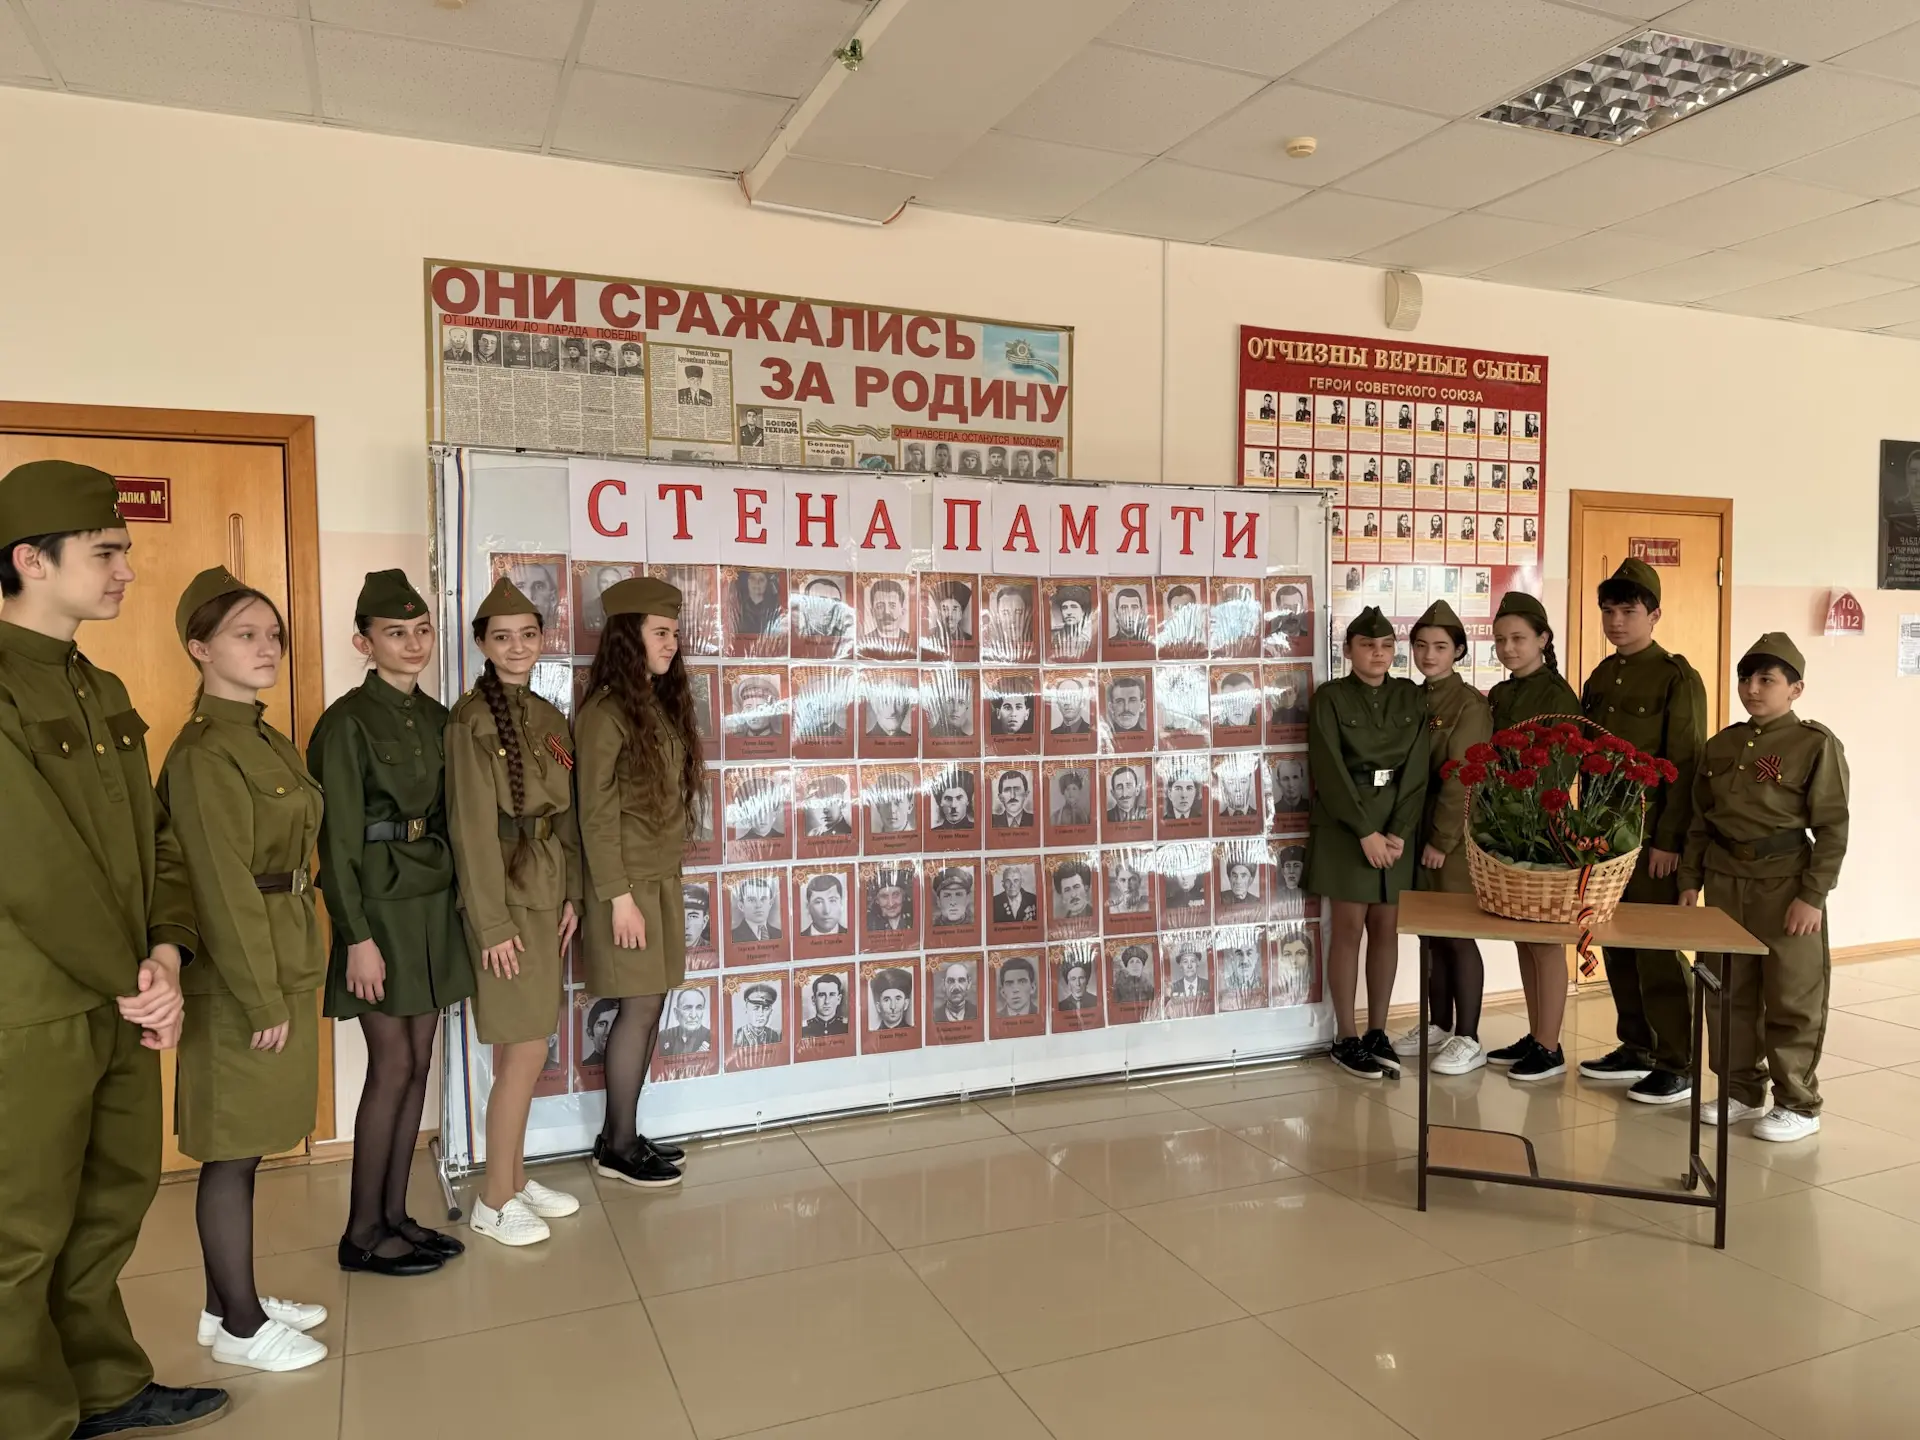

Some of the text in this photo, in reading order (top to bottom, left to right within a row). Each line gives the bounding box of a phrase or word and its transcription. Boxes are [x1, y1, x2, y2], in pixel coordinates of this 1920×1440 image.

[431, 266, 976, 360] ОНИ СРАЖАЛИСЬ
[443, 313, 641, 341] ОТ ШАЛУШКИ ДО ПАРАДА ПОБЕДЫ
[1247, 336, 1542, 384] ОТЧИЗНЫ ВЕРНЫЕ СЫНЫ
[760, 357, 1069, 424] ЗА РОДИНУ
[1309, 376, 1483, 403] ГЕРОИ СОВЕТСКОГО СОЮЗА
[764, 426, 799, 435] ТЕХНАРЬ
[765, 420, 798, 428] БОЕВОЙ
[894, 427, 1060, 448] ОНИ НАВСЕГДА ОСТАНУТСЯ МОЛОДЫМИ
[586, 478, 1261, 560] СТЕНА ПАМЯТИ
[1633, 543, 1646, 558] 17
[1840, 615, 1860, 627] 112
